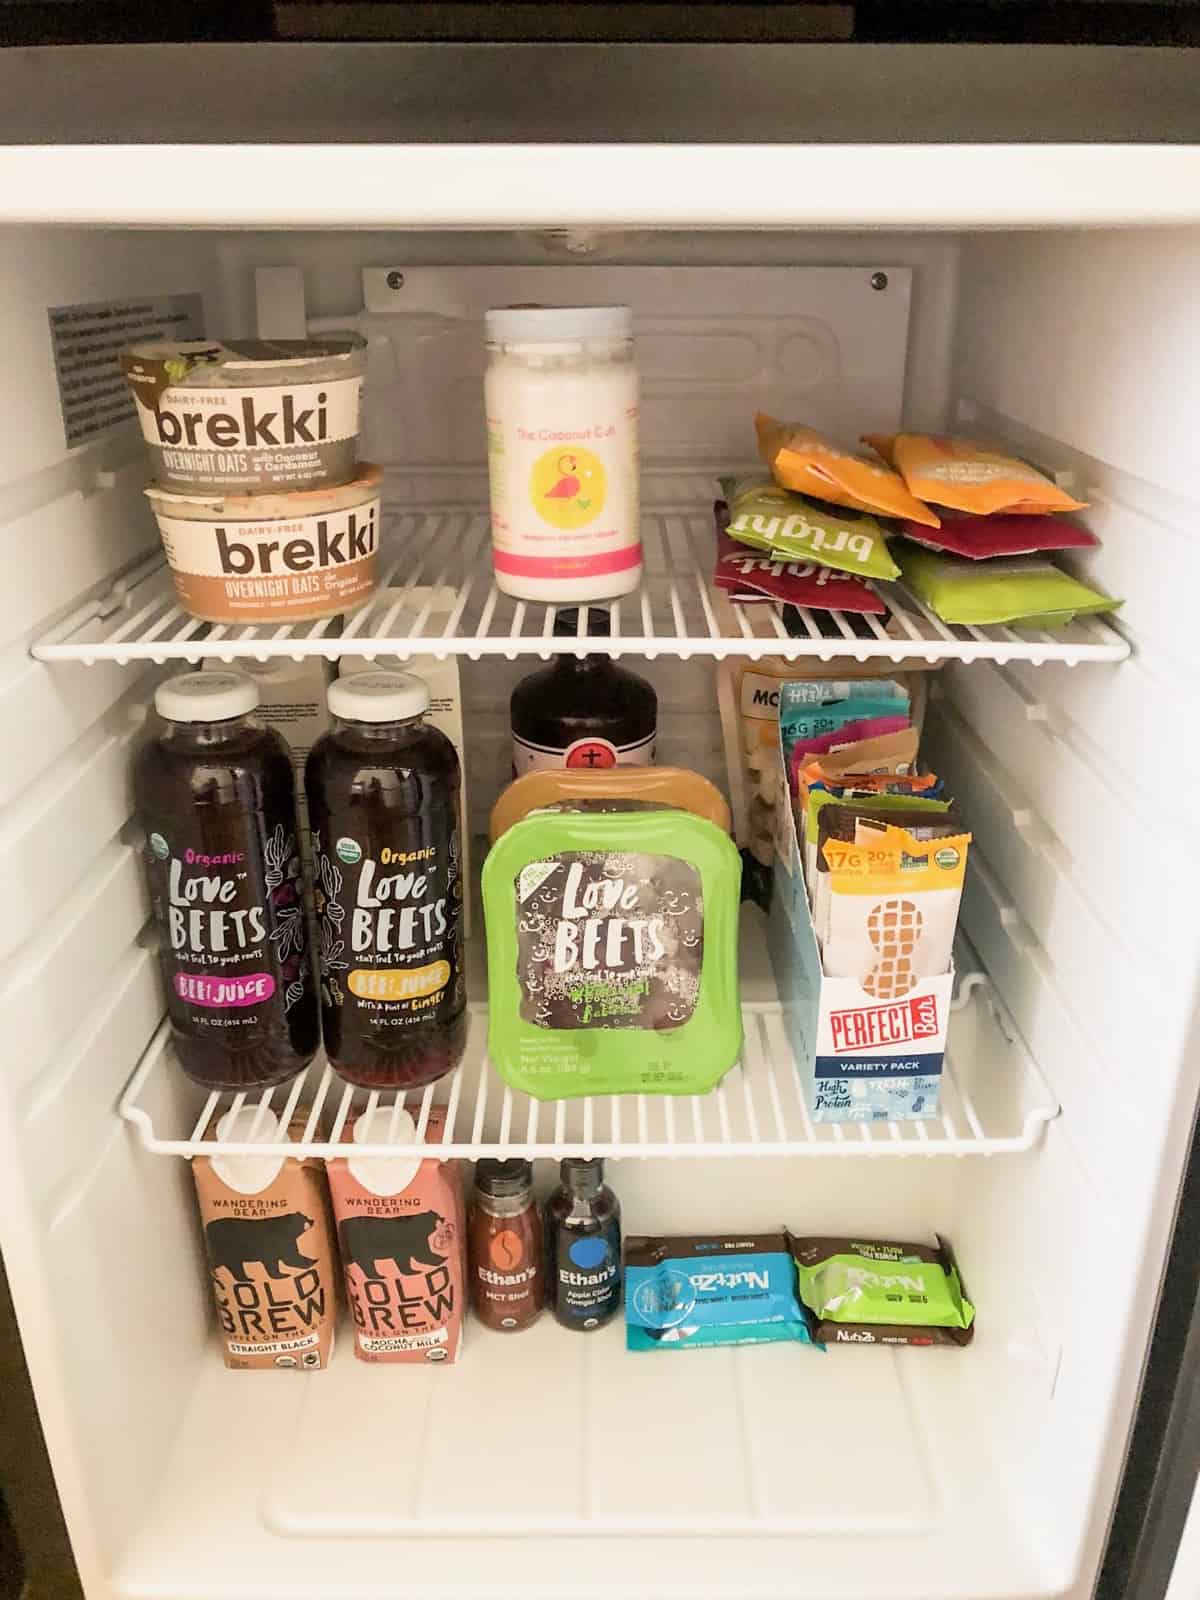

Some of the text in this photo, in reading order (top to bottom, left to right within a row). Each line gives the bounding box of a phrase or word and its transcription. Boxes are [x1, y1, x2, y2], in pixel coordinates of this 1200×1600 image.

[155, 392, 327, 447] brekki
[162, 450, 248, 473] OVERNIGHT OATS
[238, 524, 304, 536] DAIRY-FREE
[215, 508, 374, 574] brekki
[225, 578, 289, 598] OVERNIGHT
[292, 576, 320, 594] OATS
[185, 848, 244, 867] Organic
[381, 847, 436, 866] Organic
[169, 858, 238, 906] Love
[357, 859, 428, 908] Love
[562, 862, 639, 919] Love
[168, 905, 266, 952] BEETS
[352, 899, 448, 952] BEETS
[553, 918, 665, 974] BEETS
[180, 976, 211, 1000] BEET
[829, 996, 936, 1049] PERFECT Bar
[840, 1062, 919, 1071] VARIETY PACK
[816, 1095, 851, 1110] Protein
[213, 1199, 288, 1208] WANDERING
[234, 1208, 266, 1216] BEAR
[345, 1198, 421, 1207] WANDERING
[367, 1207, 400, 1215] BEAR
[478, 1266, 537, 1286] Ethan's
[559, 1265, 616, 1286] Ethan's
[689, 1270, 769, 1291] NuttZo
[486, 1290, 506, 1302] MCT
[218, 1288, 325, 1335] BREW
[353, 1285, 454, 1331] BREW
[231, 1337, 314, 1352] STRAIGHT BLACK
[364, 1343, 413, 1351] COCONUT
[417, 1337, 441, 1347] MILK
[371, 1338, 408, 1346] MOCHA
